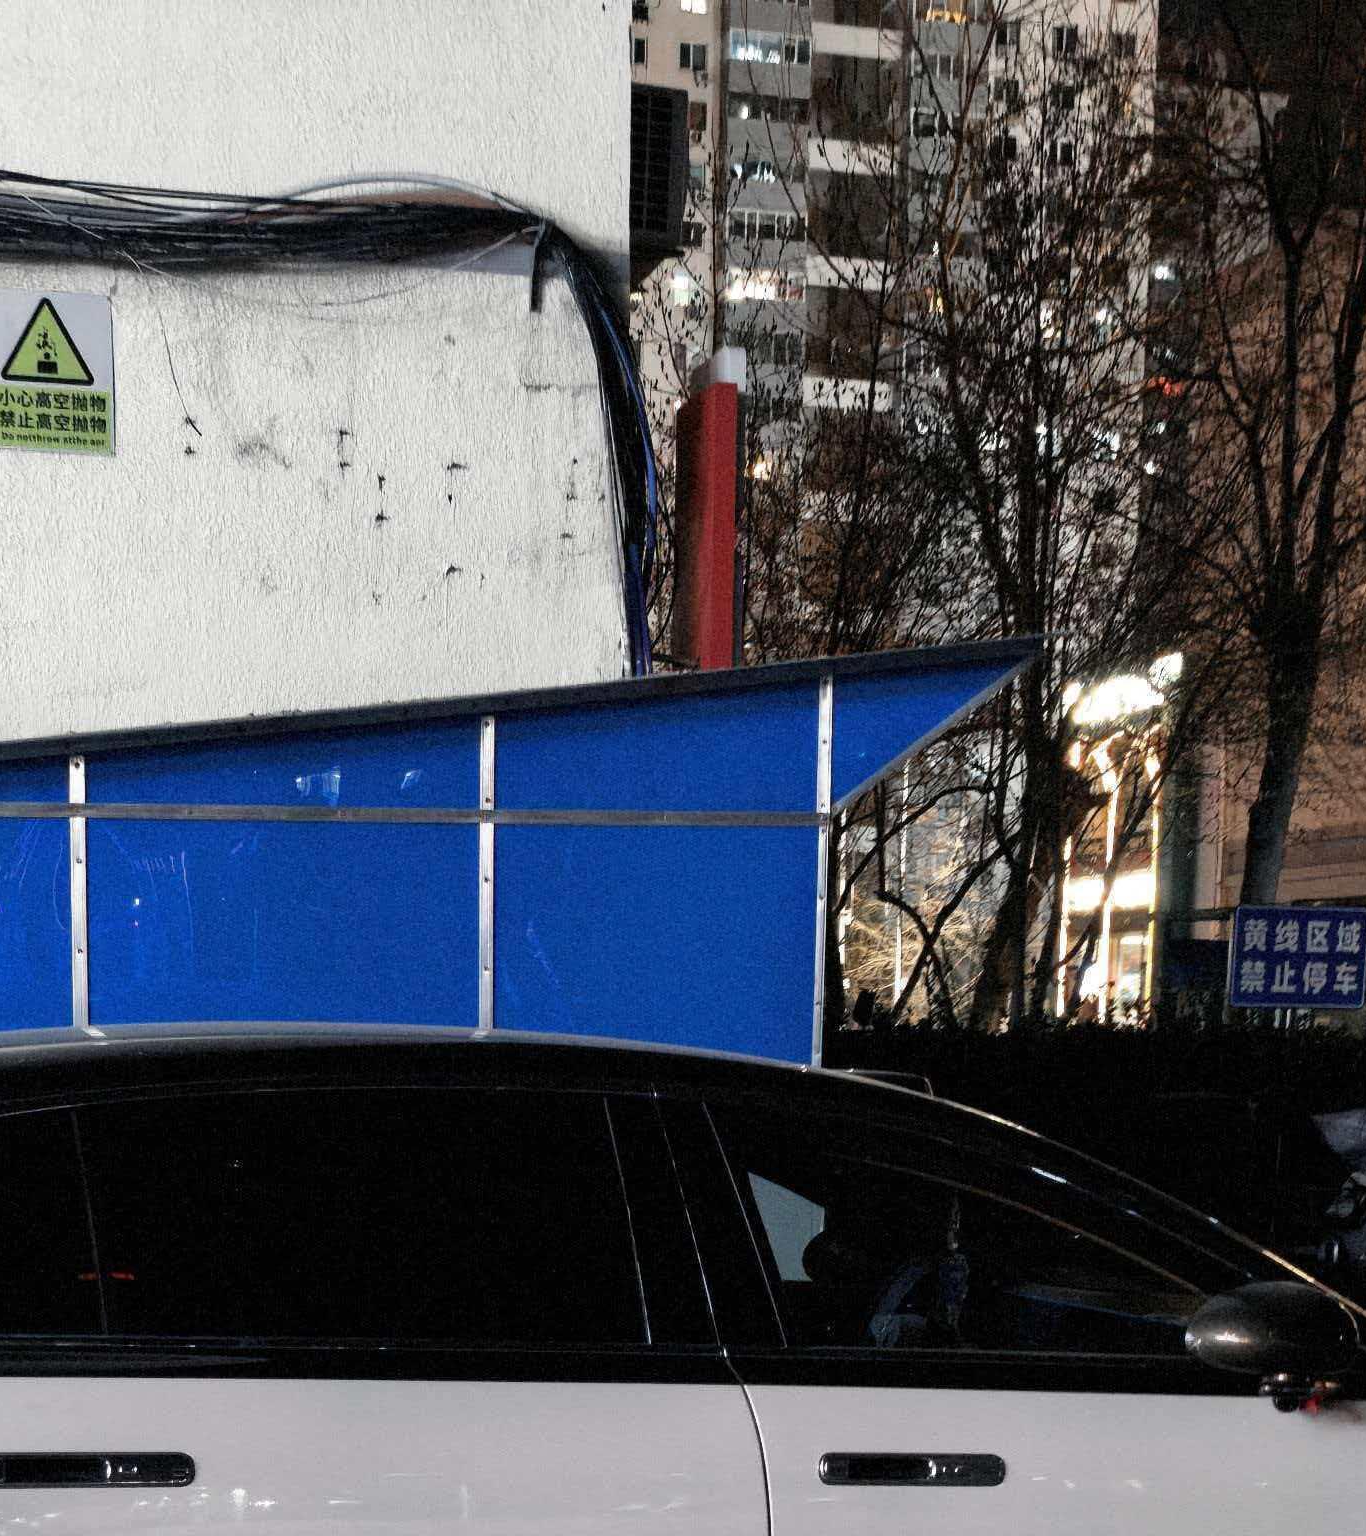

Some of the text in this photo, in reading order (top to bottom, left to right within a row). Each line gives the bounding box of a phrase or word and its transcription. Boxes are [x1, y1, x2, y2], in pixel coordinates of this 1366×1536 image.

[0, 387, 106, 412] 小心高空抛物
[0, 410, 107, 434] 禁止高空抛物
[1243, 918, 1363, 954] 黄线区域
[1239, 960, 1359, 996] 禁止停车
